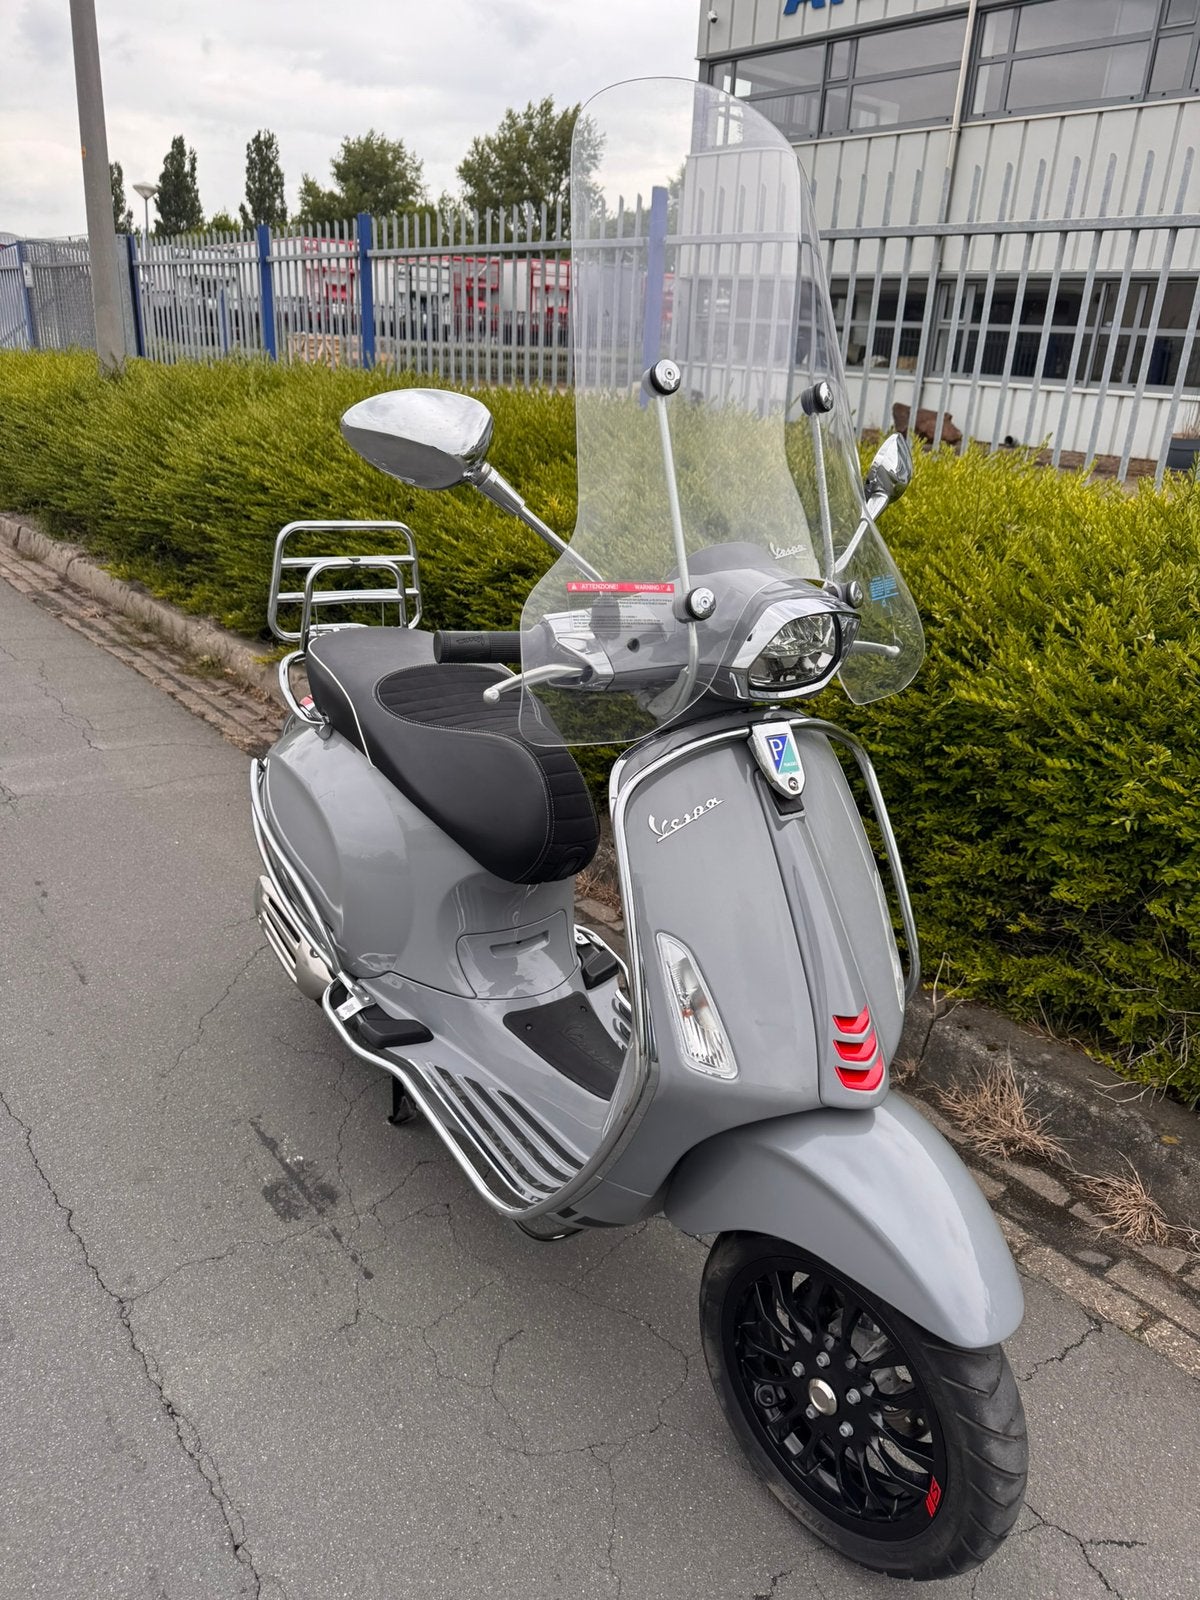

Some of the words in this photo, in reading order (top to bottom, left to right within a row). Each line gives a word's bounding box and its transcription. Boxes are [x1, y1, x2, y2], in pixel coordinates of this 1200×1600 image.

[769, 541, 807, 560] Vespa
[769, 738, 783, 760] P
[648, 797, 725, 843] Vespa
